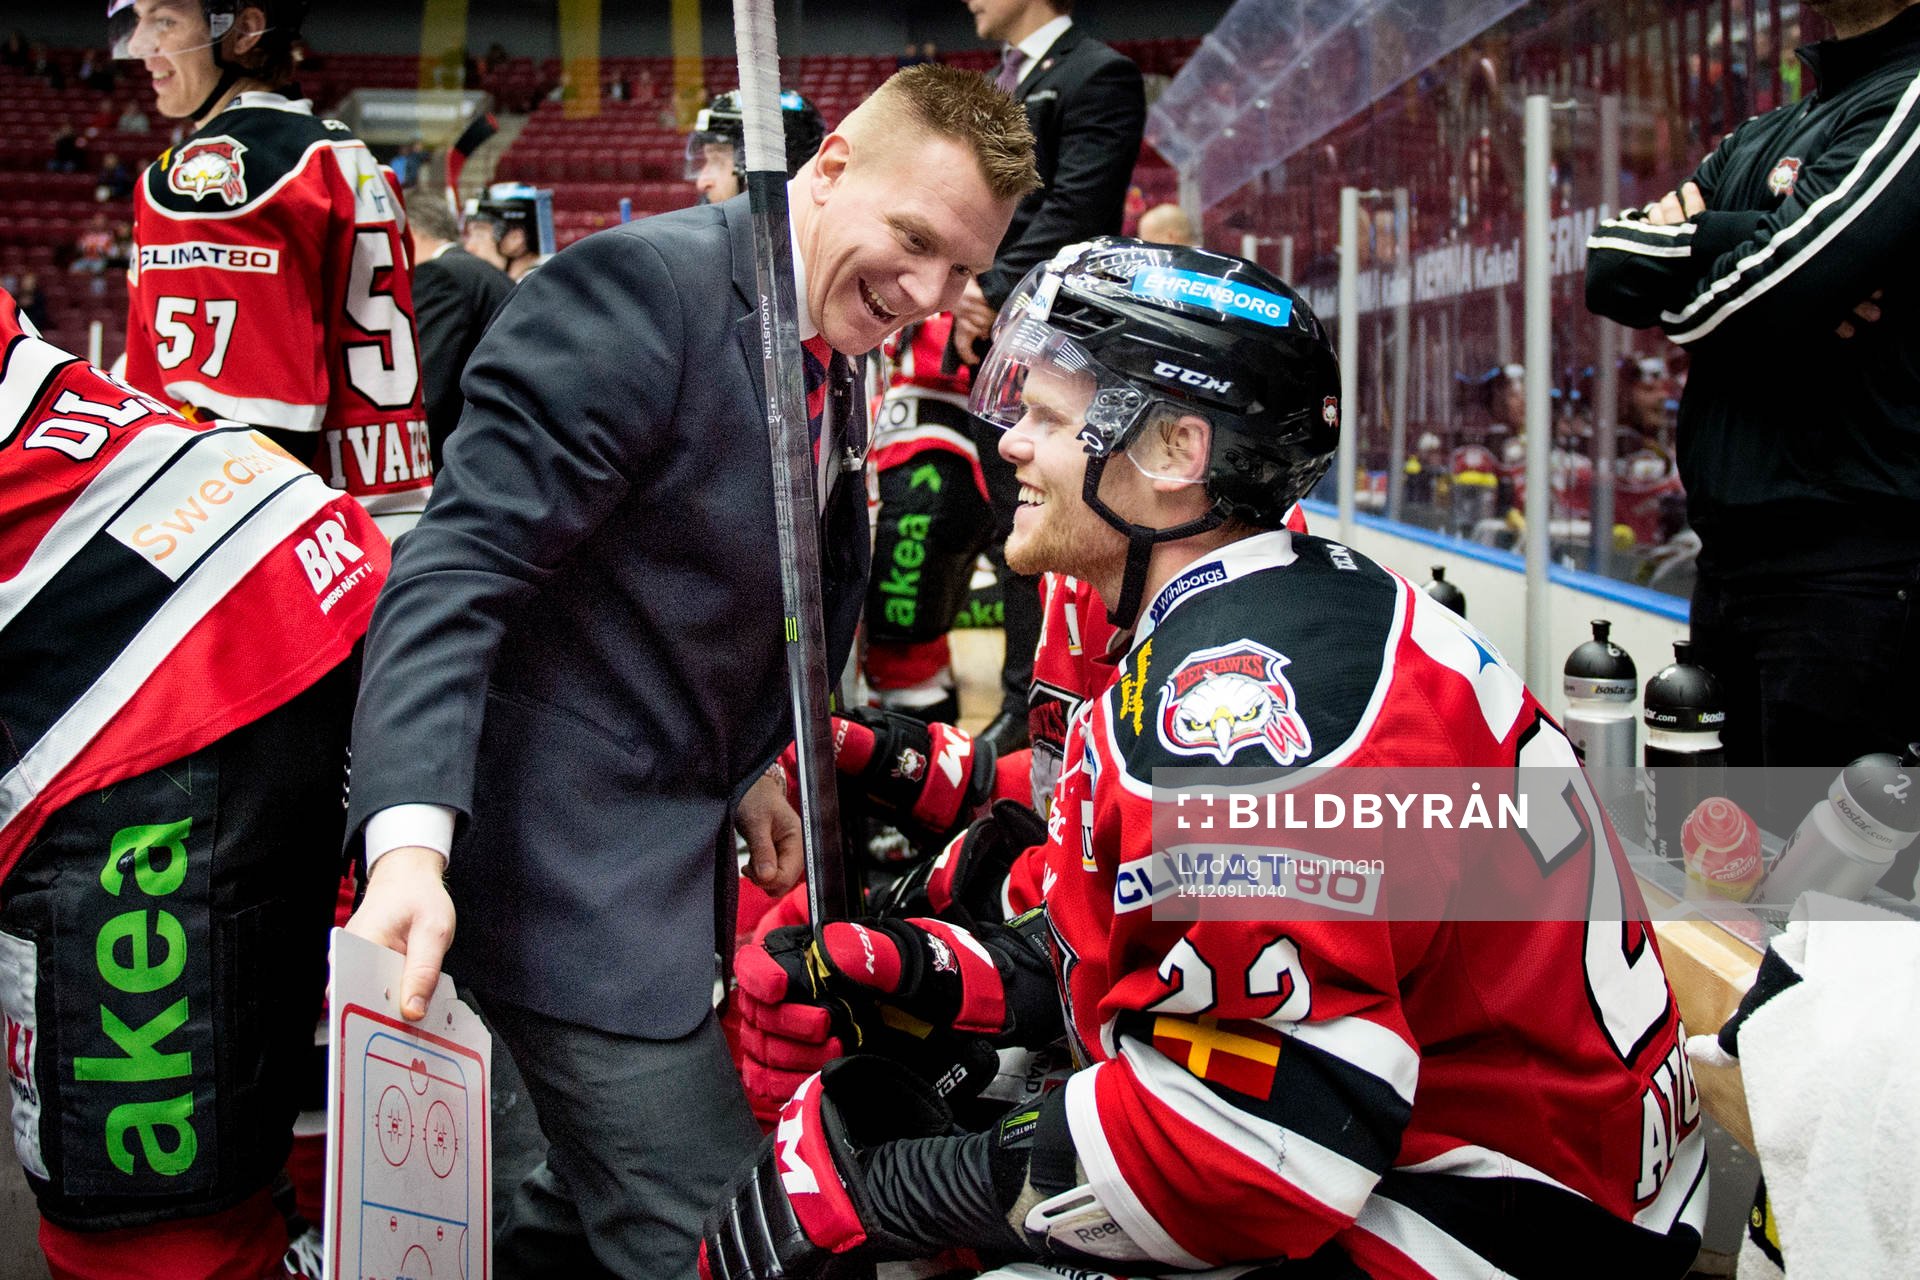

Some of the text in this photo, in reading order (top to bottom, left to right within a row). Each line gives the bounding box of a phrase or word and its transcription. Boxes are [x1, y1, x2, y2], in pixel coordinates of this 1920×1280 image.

[345, 227, 420, 411] 5
[761, 294, 772, 360] AUGUSTIN
[1142, 274, 1281, 319] EHRENBORG
[154, 294, 238, 379] 57
[1152, 360, 1234, 394] CCM
[879, 513, 932, 627] akea
[1157, 567, 1224, 611] Wihlborgs
[1175, 654, 1265, 691] REDHAWKS
[74, 816, 198, 1176] akea
[1146, 934, 1312, 1022] 22
[1074, 1221, 1119, 1243] Ree
